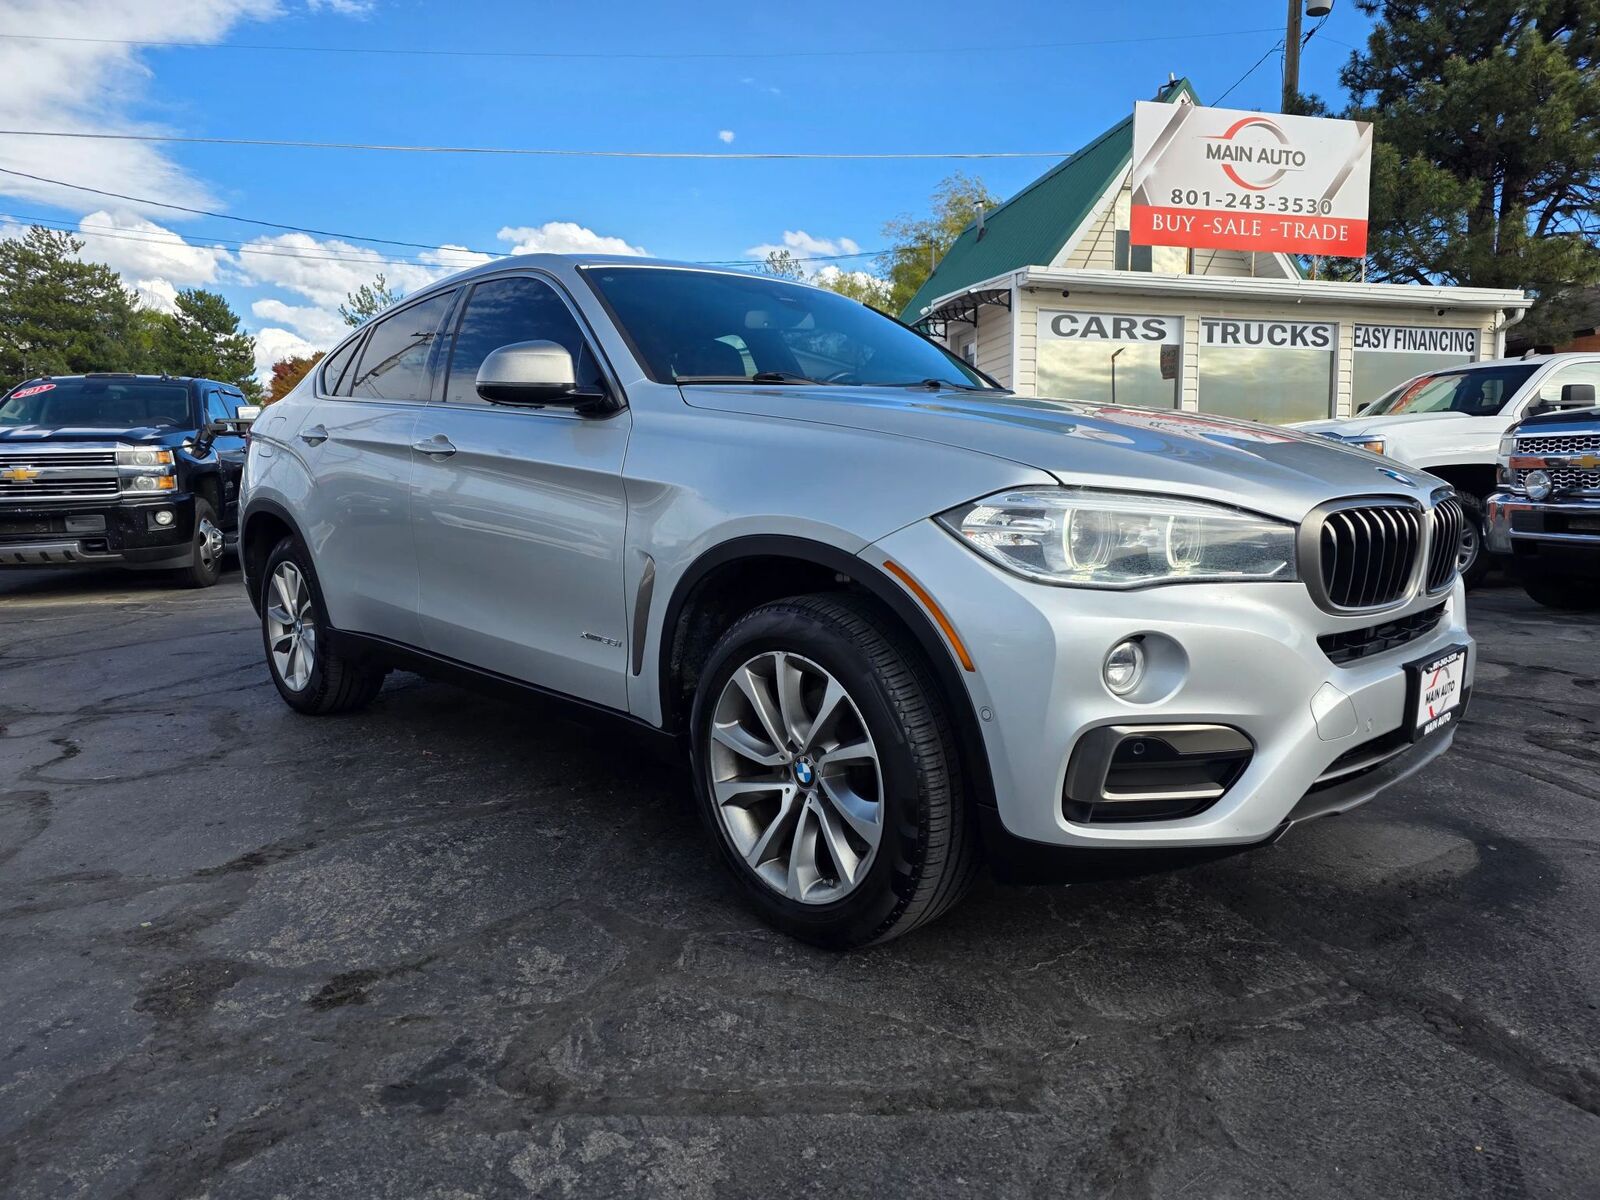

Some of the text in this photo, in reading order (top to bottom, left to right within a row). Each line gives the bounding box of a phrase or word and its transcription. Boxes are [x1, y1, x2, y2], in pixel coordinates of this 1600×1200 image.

[1206, 143, 1306, 167] MAIN AUTO
[1170, 188, 1333, 215] 801-243-3530
[1152, 213, 1196, 232] BUY
[1050, 314, 1167, 341] CARS
[1201, 321, 1330, 348] TRUCKS
[1353, 326, 1475, 353] EASY FINANCING
[1425, 680, 1455, 704] MAIN AUTO
[1438, 711, 1451, 727] AUTO
